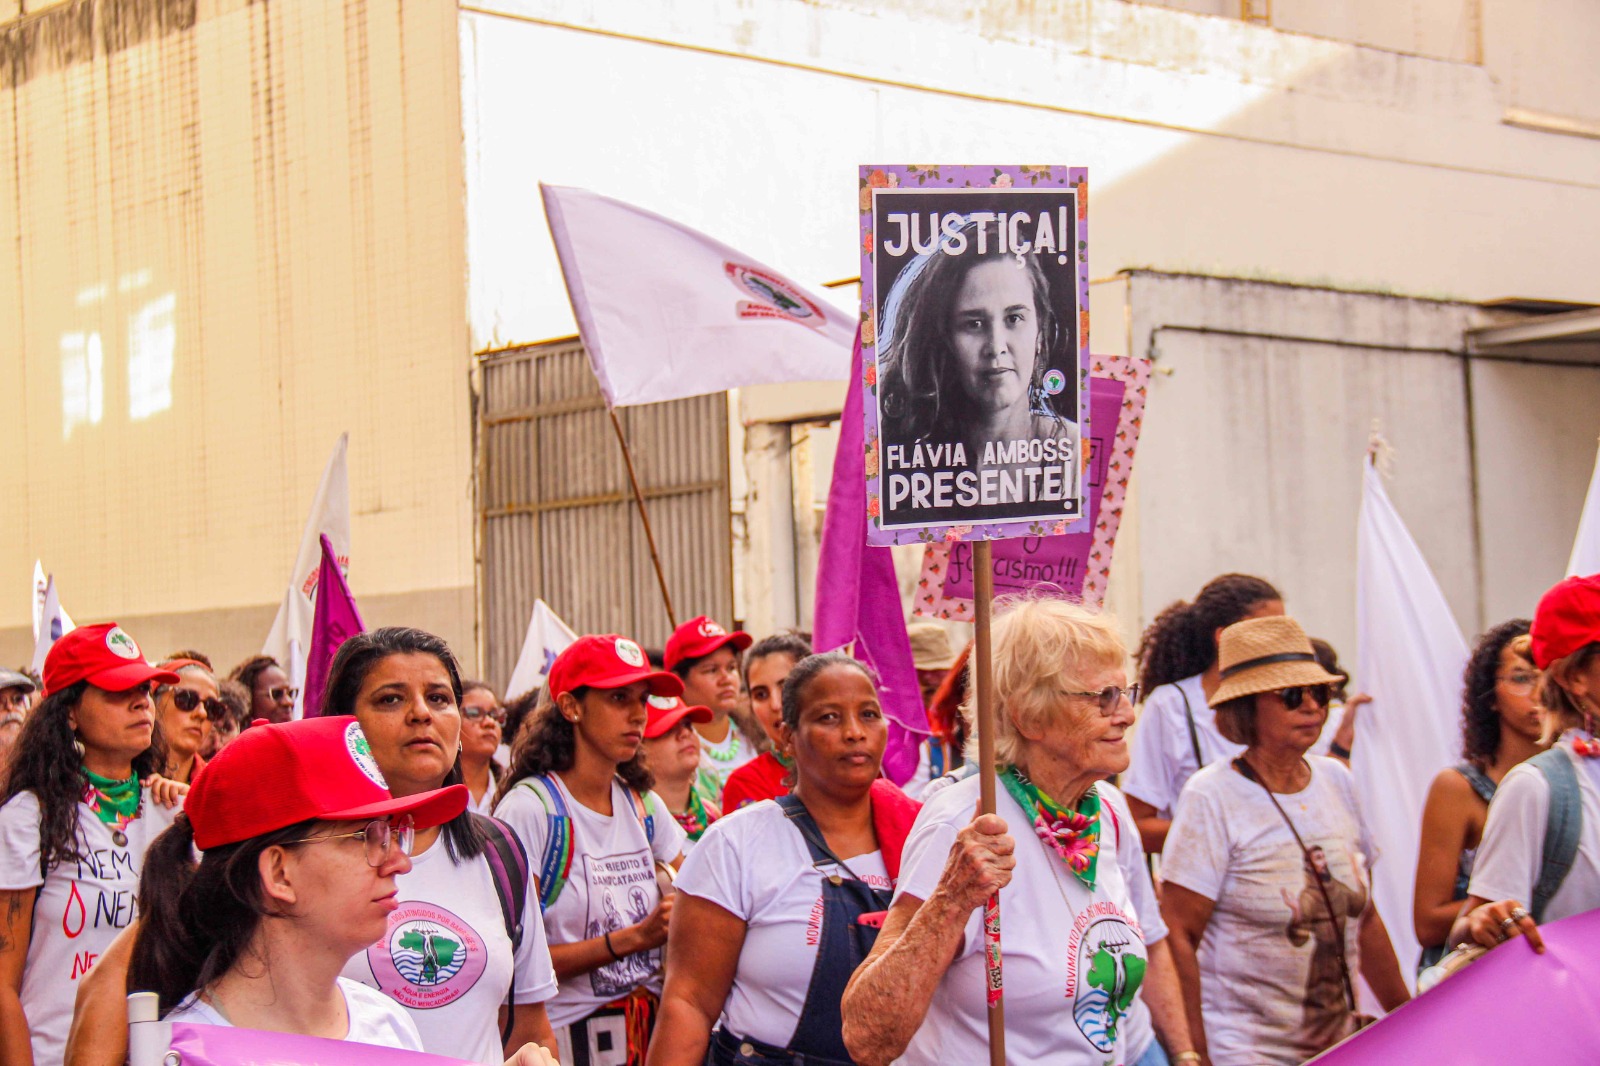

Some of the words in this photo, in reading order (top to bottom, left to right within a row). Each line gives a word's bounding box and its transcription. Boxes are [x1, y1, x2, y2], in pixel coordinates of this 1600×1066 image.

[884, 205, 1067, 269] JUSTIÇA!
[887, 438, 968, 469] FLÁVIA
[983, 437, 1074, 466] AMBOSS
[889, 461, 1073, 510] PRESENTE!
[949, 543, 1078, 586] fcismo!!!
[77, 848, 139, 880] NEM
[1065, 929, 1080, 998] MOVIMENTO
[393, 989, 404, 1000] NÃO
[404, 997, 417, 1006] SÃO
[424, 987, 450, 999] ENERGIA
